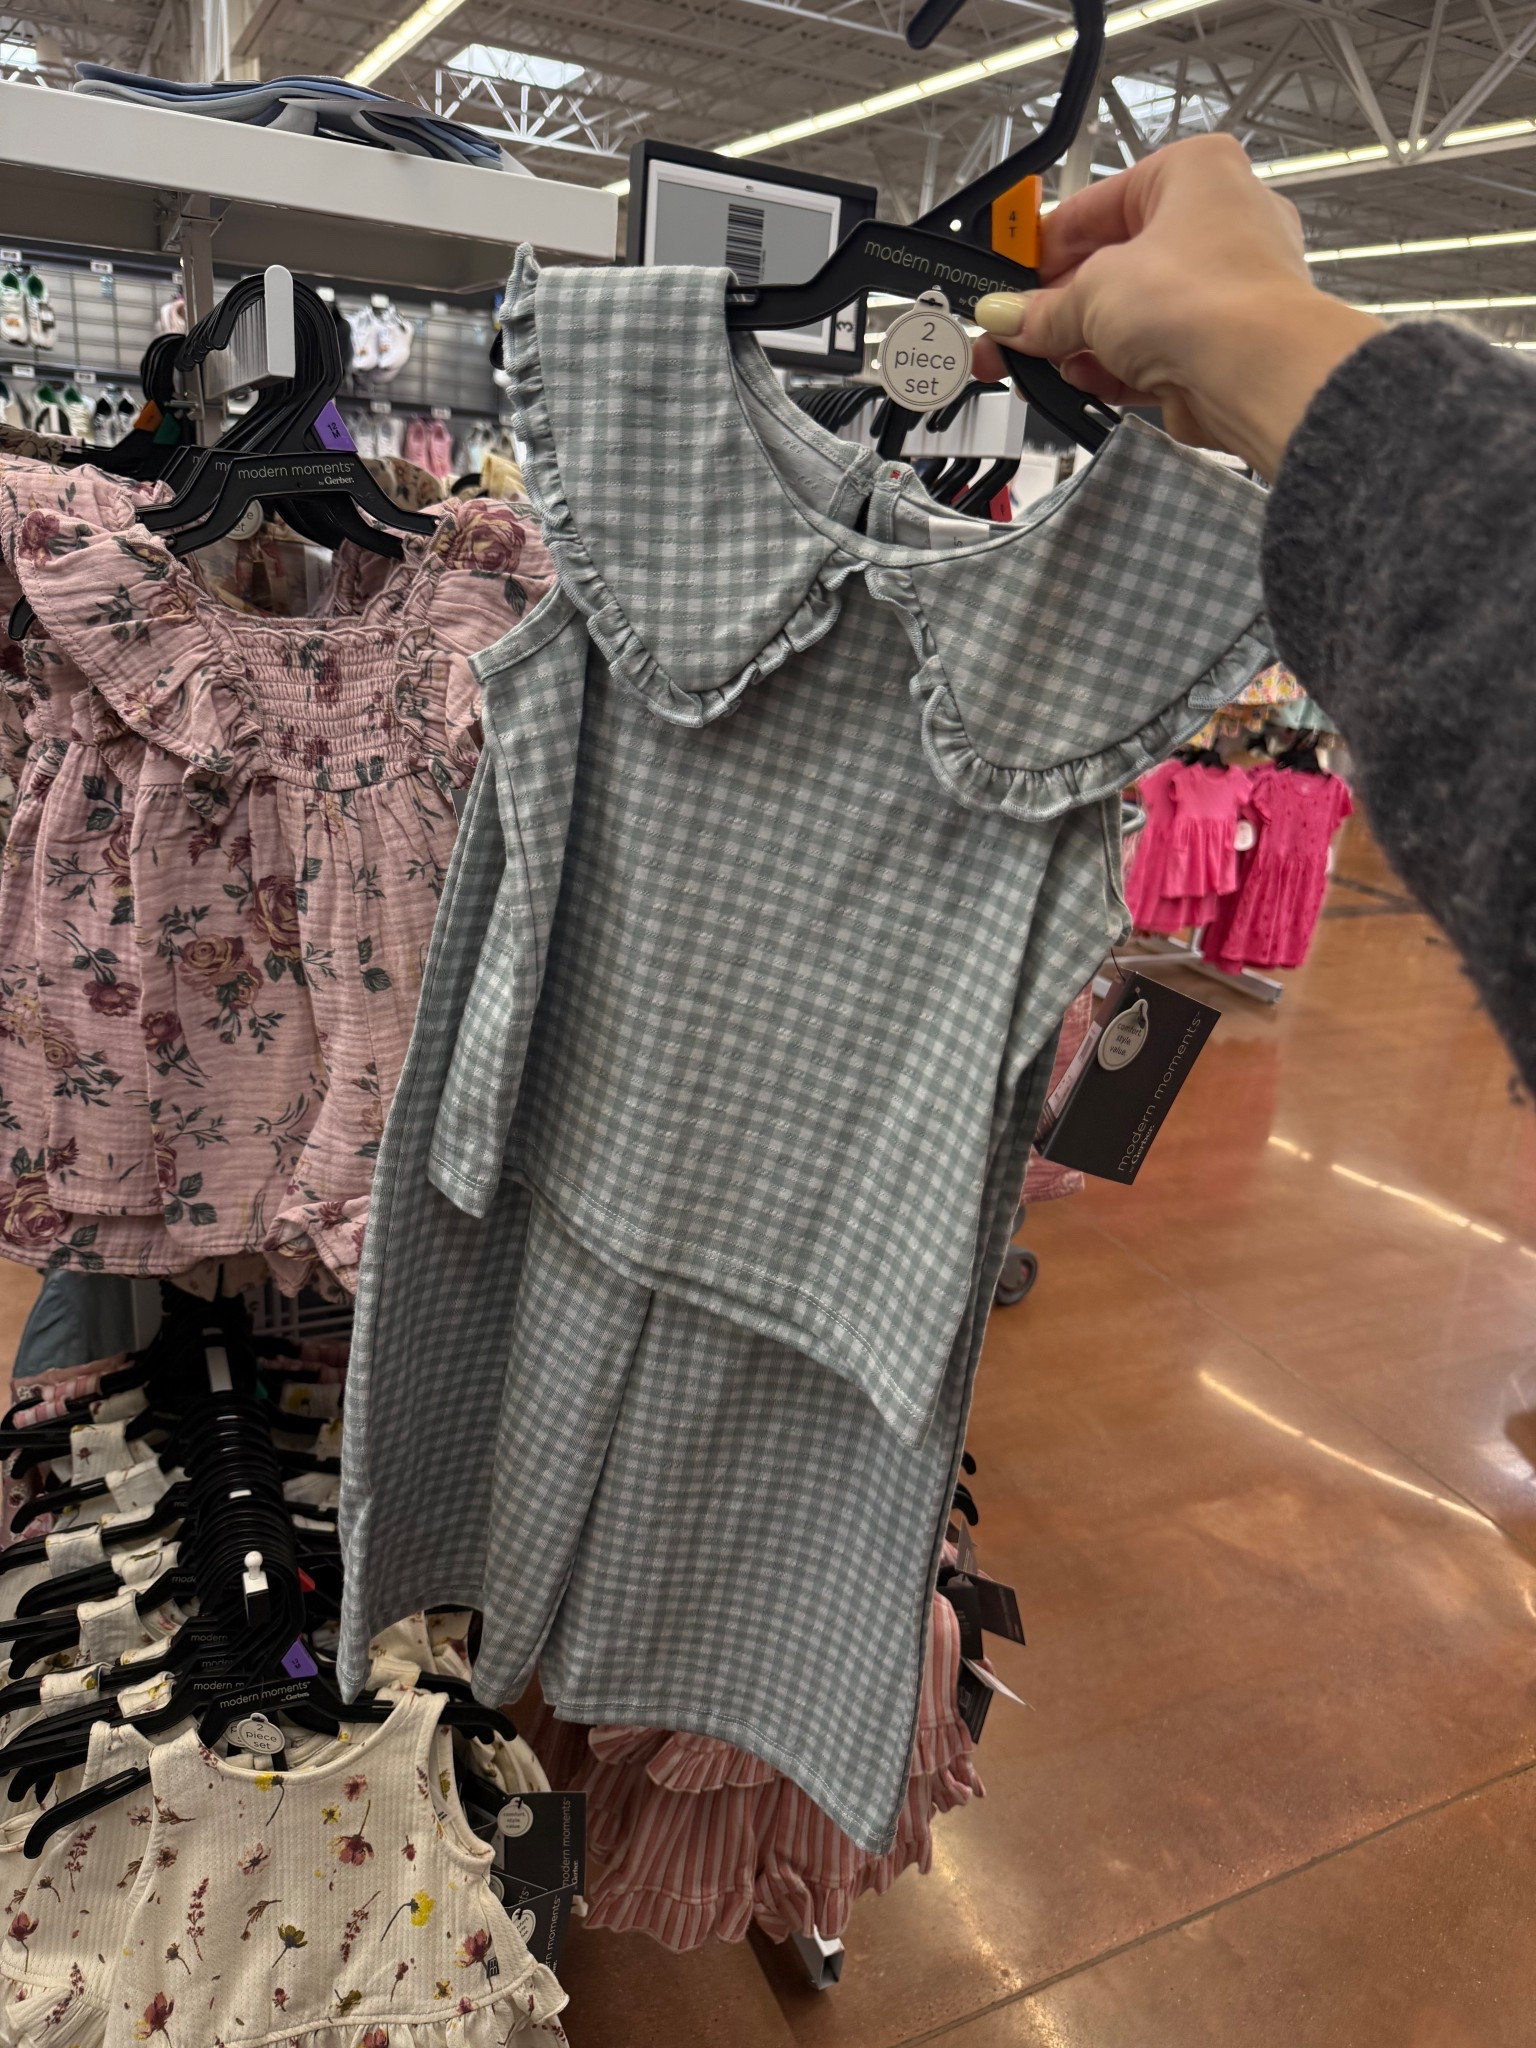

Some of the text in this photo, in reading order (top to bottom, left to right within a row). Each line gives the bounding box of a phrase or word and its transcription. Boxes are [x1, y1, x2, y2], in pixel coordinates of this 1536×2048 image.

[1008, 210, 1017, 222] 4
[1008, 226, 1017, 238] T
[864, 240, 930, 274] modern
[922, 322, 935, 342] 2
[894, 347, 956, 371] piece
[904, 376, 940, 396] set
[238, 465, 289, 480] modern
[1117, 1104, 1156, 1171] modern
[193, 1680, 233, 1691] modern
[219, 1691, 259, 1709] modern
[256, 1723, 264, 1732] 2
[245, 1730, 277, 1743] piece
[253, 1740, 271, 1750] set
[560, 1849, 571, 1888] modern
